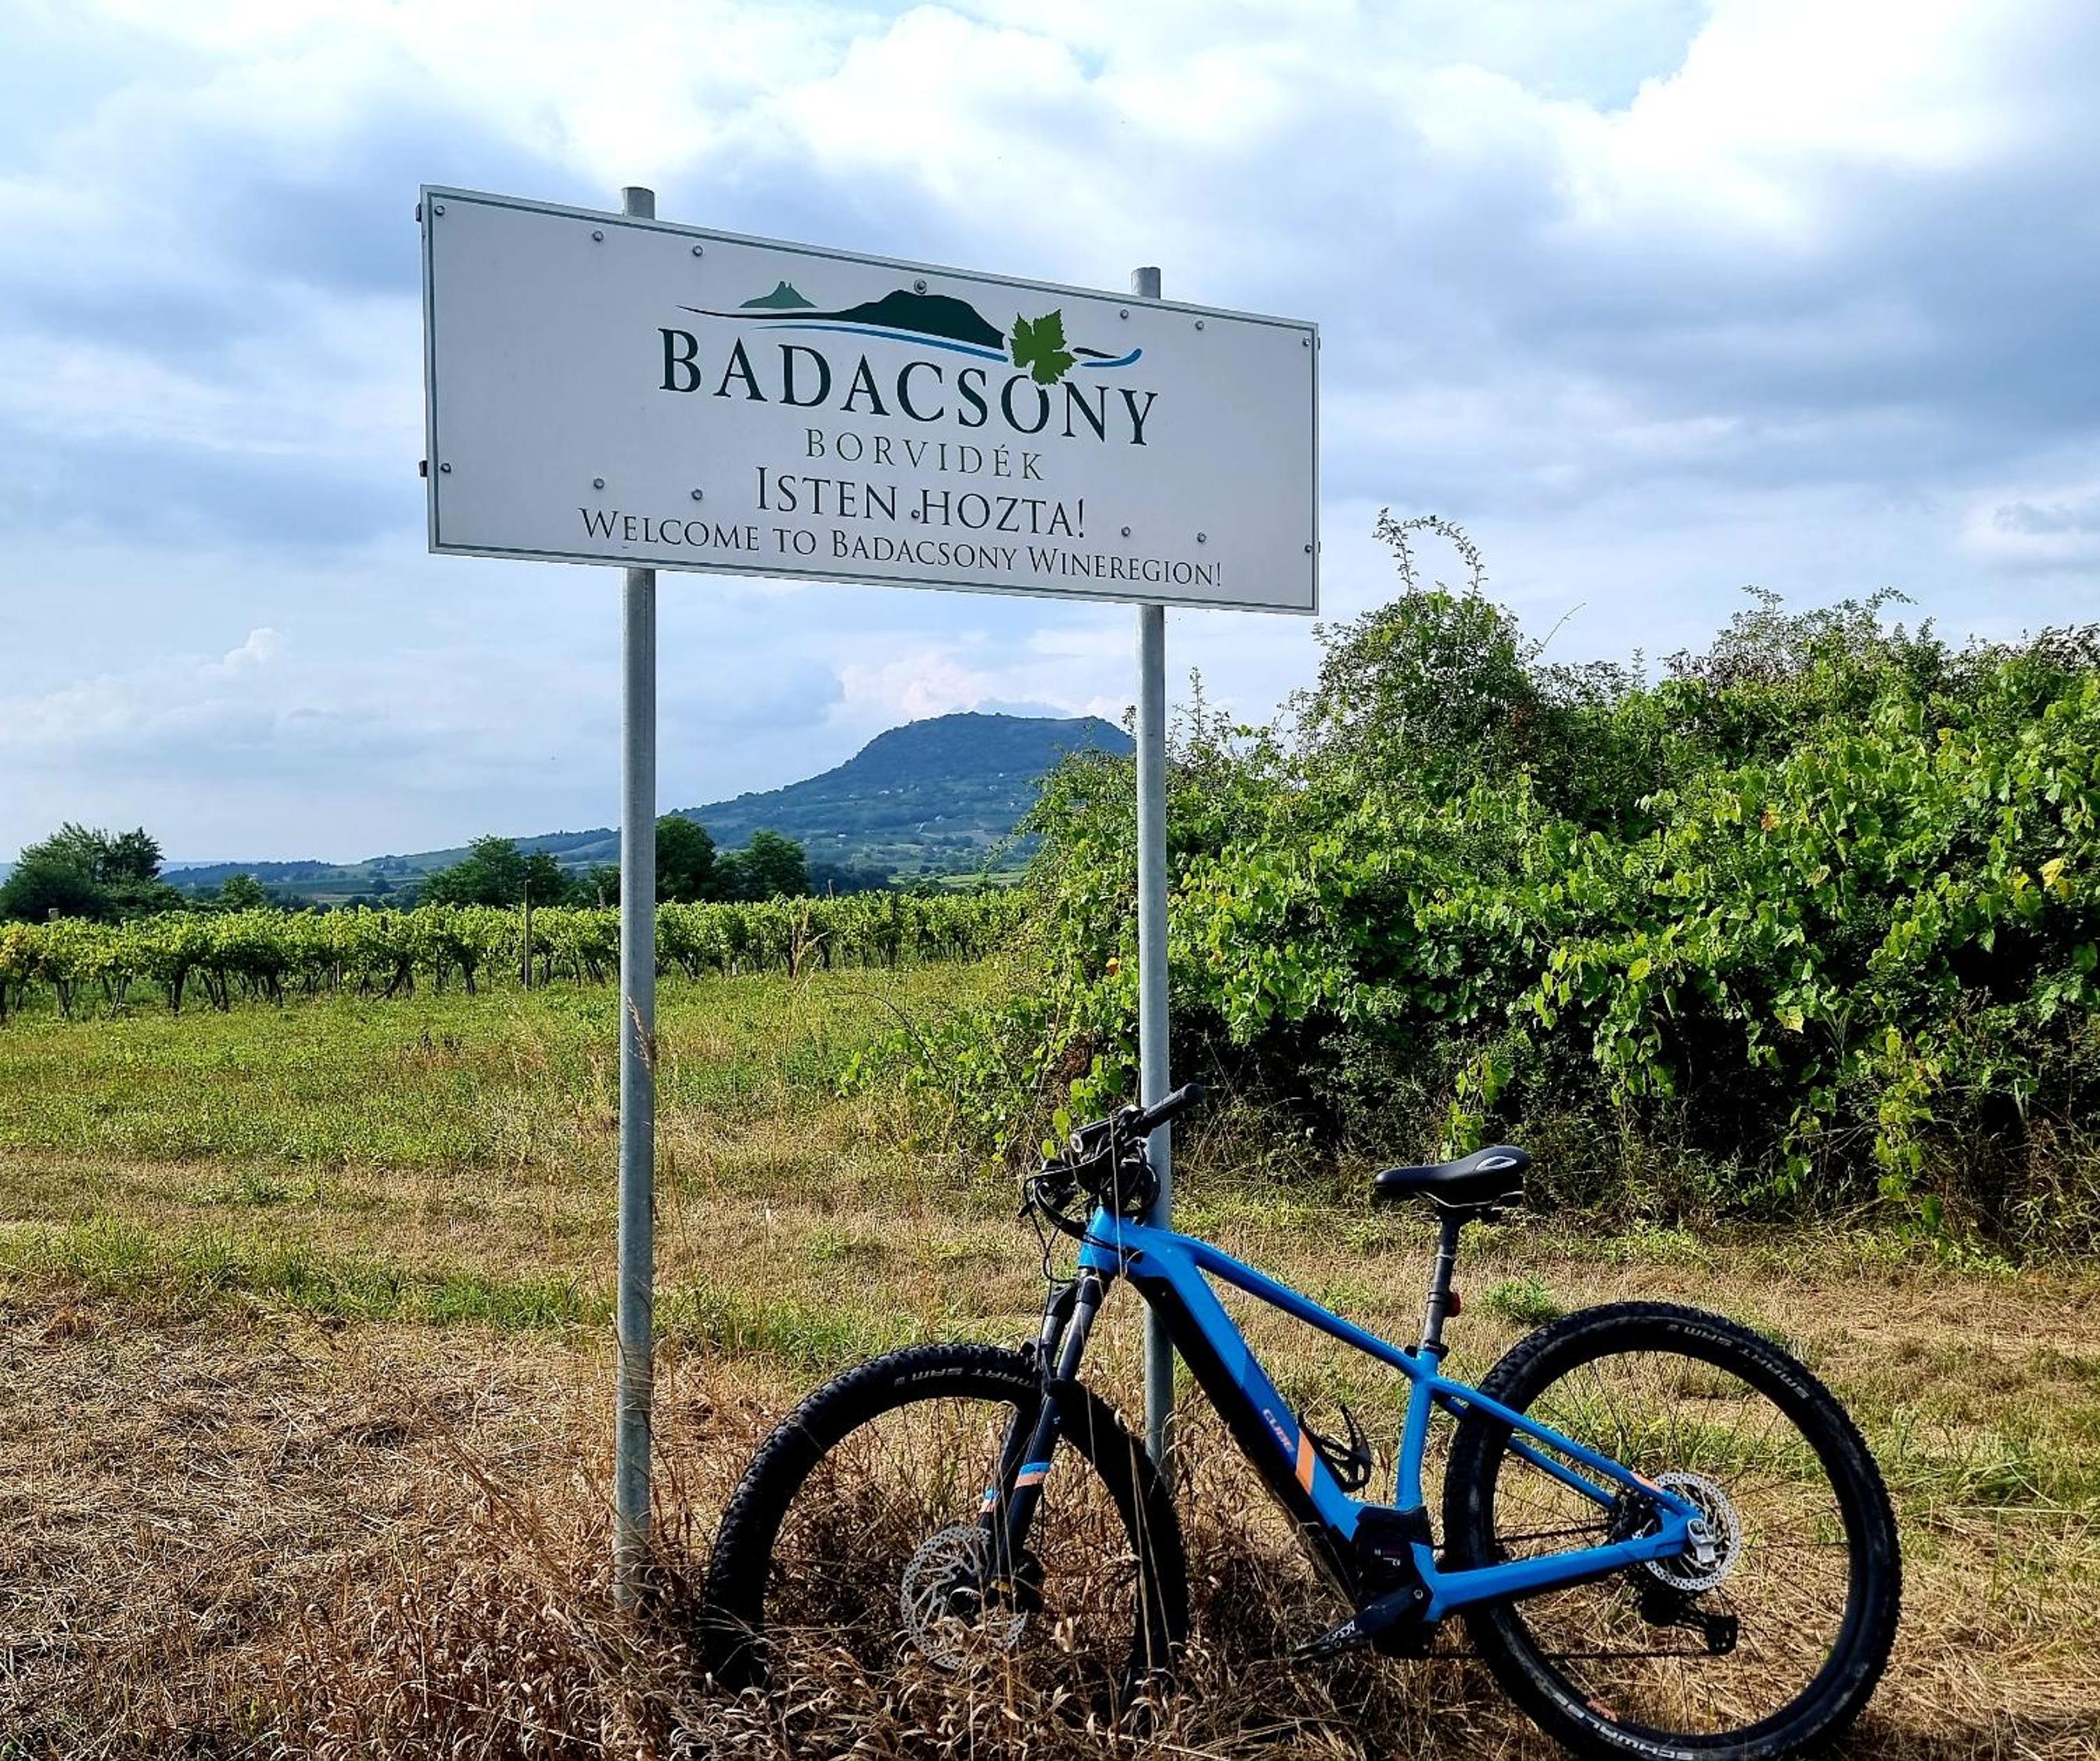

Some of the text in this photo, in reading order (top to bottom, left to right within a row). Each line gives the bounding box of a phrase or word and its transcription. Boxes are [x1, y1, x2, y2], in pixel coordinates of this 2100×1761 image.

[658, 327, 1159, 446] BADACSONY
[806, 427, 1045, 482] BORVIDÉK
[756, 467, 1086, 538] ISTEN HOZTA!
[578, 507, 1222, 586] WELCOME TO BADACSONY WINEREGION!
